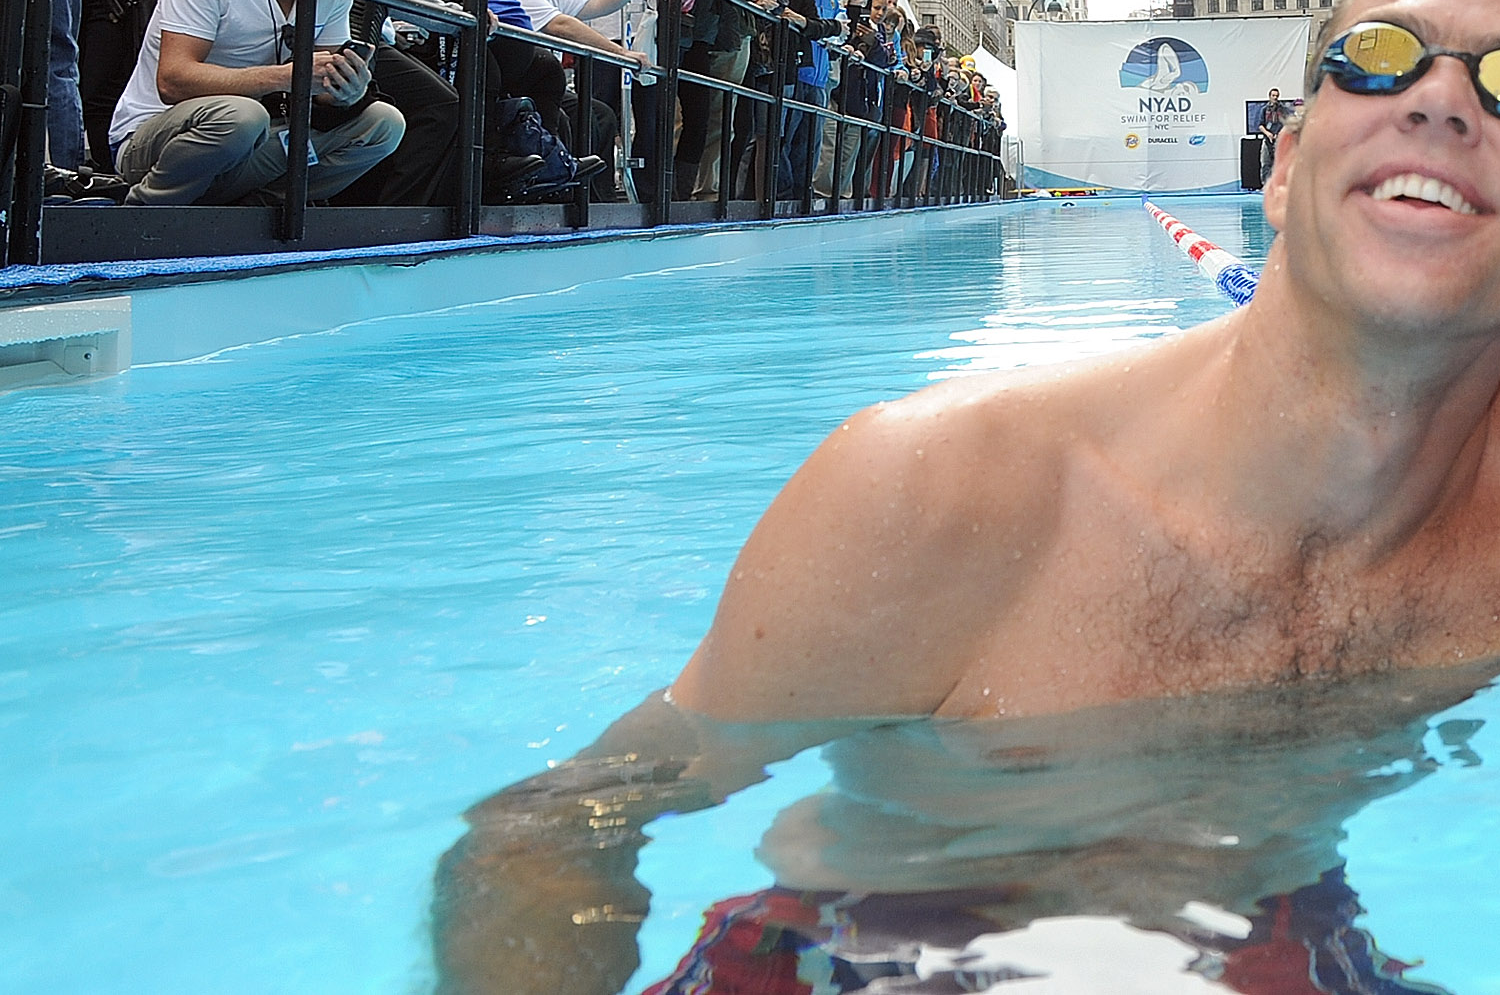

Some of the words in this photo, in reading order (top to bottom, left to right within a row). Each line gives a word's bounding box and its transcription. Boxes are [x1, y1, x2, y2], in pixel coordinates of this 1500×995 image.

[1139, 98, 1192, 112] NYAD
[1121, 116, 1147, 124] SWIM
[1150, 114, 1170, 123] FOR
[1173, 114, 1206, 123] RELIEF
